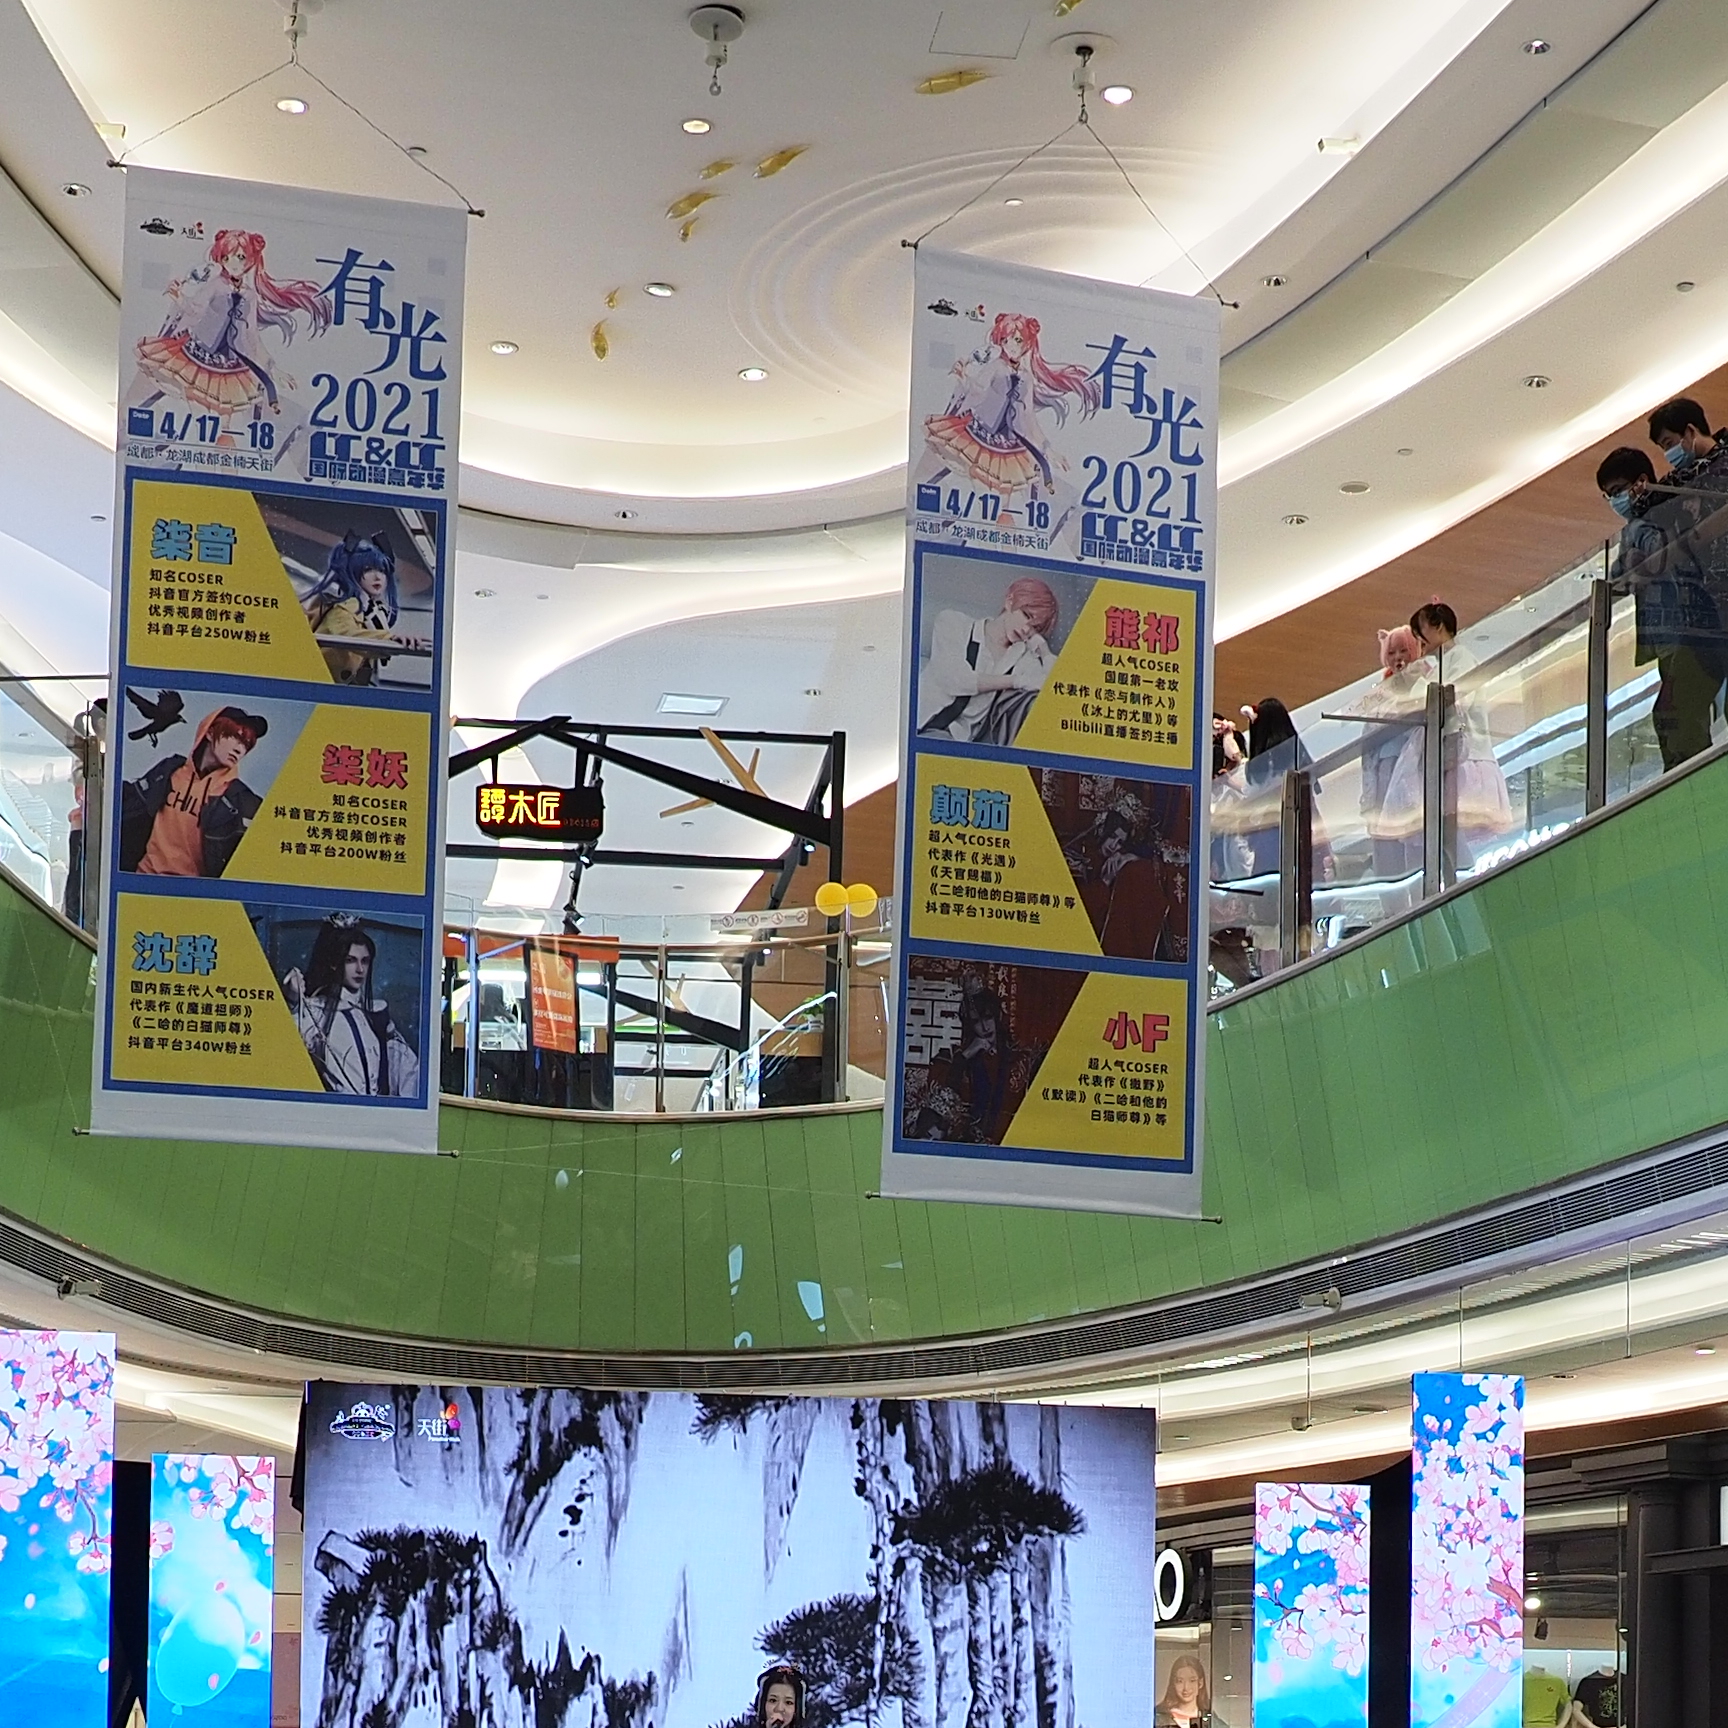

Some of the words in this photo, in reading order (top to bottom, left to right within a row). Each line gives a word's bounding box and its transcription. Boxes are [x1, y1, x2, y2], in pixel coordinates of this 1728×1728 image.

[313, 248, 447, 381] 有光
[309, 374, 445, 440] 2021
[1085, 333, 1204, 466] 有光
[1080, 455, 1202, 524] 2021
[149, 568, 224, 586] 知名COSER
[148, 587, 279, 609] 抖音官方签约COSER
[148, 604, 245, 624] 优秀视频创作者
[147, 622, 272, 644] 抖音平台250W粉丝
[1101, 652, 1180, 675] 超人气COSER
[1104, 670, 1179, 693] 国服第一老攻
[332, 794, 408, 812] 知名COSER
[480, 788, 560, 825] 譚木匠
[273, 805, 407, 828] 抖音官方签约COSER
[307, 825, 406, 846] 优秀视频创作者
[928, 829, 1011, 850] 超人气COSER
[280, 841, 407, 863] 抖音平台200W粉丝
[928, 848, 1016, 869] 代表作《光遇》
[930, 865, 1003, 885] 《天官赐福》
[925, 901, 1041, 925] 抖音平台130W粉丝
[132, 930, 217, 976] 沈辞
[130, 980, 275, 1001] 国内新生代人气COSER
[129, 998, 253, 1019] 代表作《魔道祖师》
[133, 1017, 252, 1037] 《二哈的白猫师尊》
[1103, 1011, 1170, 1053] 小F
[128, 1035, 253, 1056] 抖音平台340W粉丝
[1088, 1057, 1169, 1076] 超人气COSER
